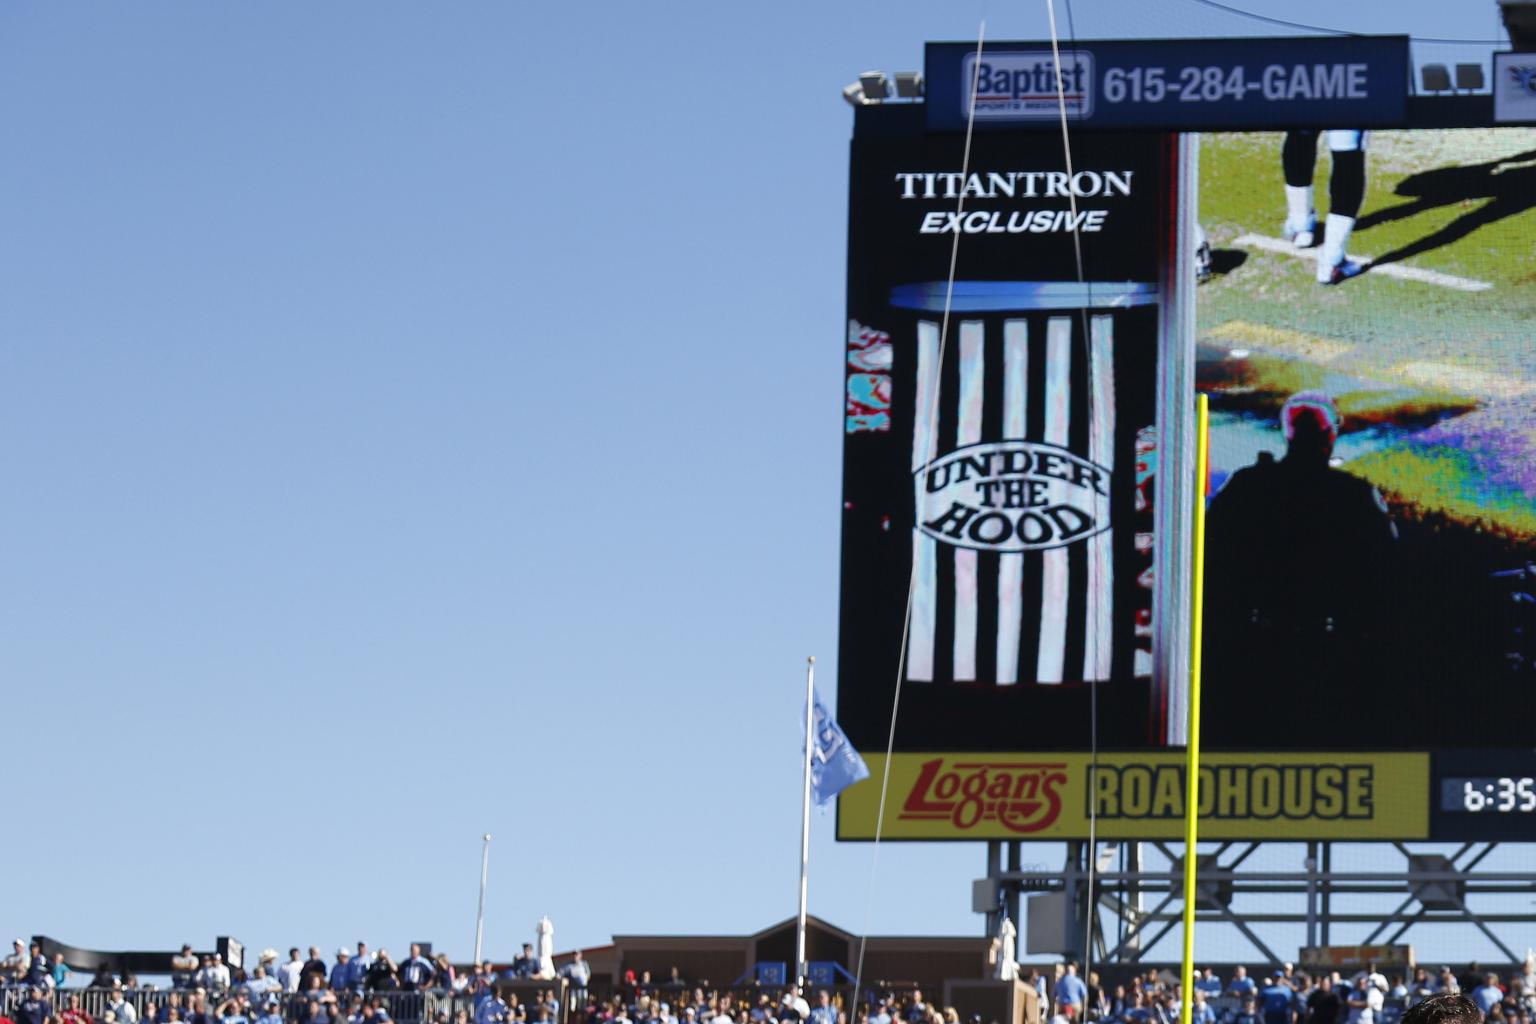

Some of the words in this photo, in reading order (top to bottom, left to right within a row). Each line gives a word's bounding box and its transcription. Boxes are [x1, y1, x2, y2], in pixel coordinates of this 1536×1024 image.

[972, 61, 1085, 99] Baptist
[1103, 63, 1368, 102] 615-284-GAME
[896, 170, 1134, 198] TITANTRON
[920, 210, 1108, 234] EXCLUSIVE
[925, 449, 1107, 496] UNDER
[976, 479, 1049, 508] THE
[923, 502, 1096, 545] HOOD
[1085, 764, 1374, 819] ROADHOUSE
